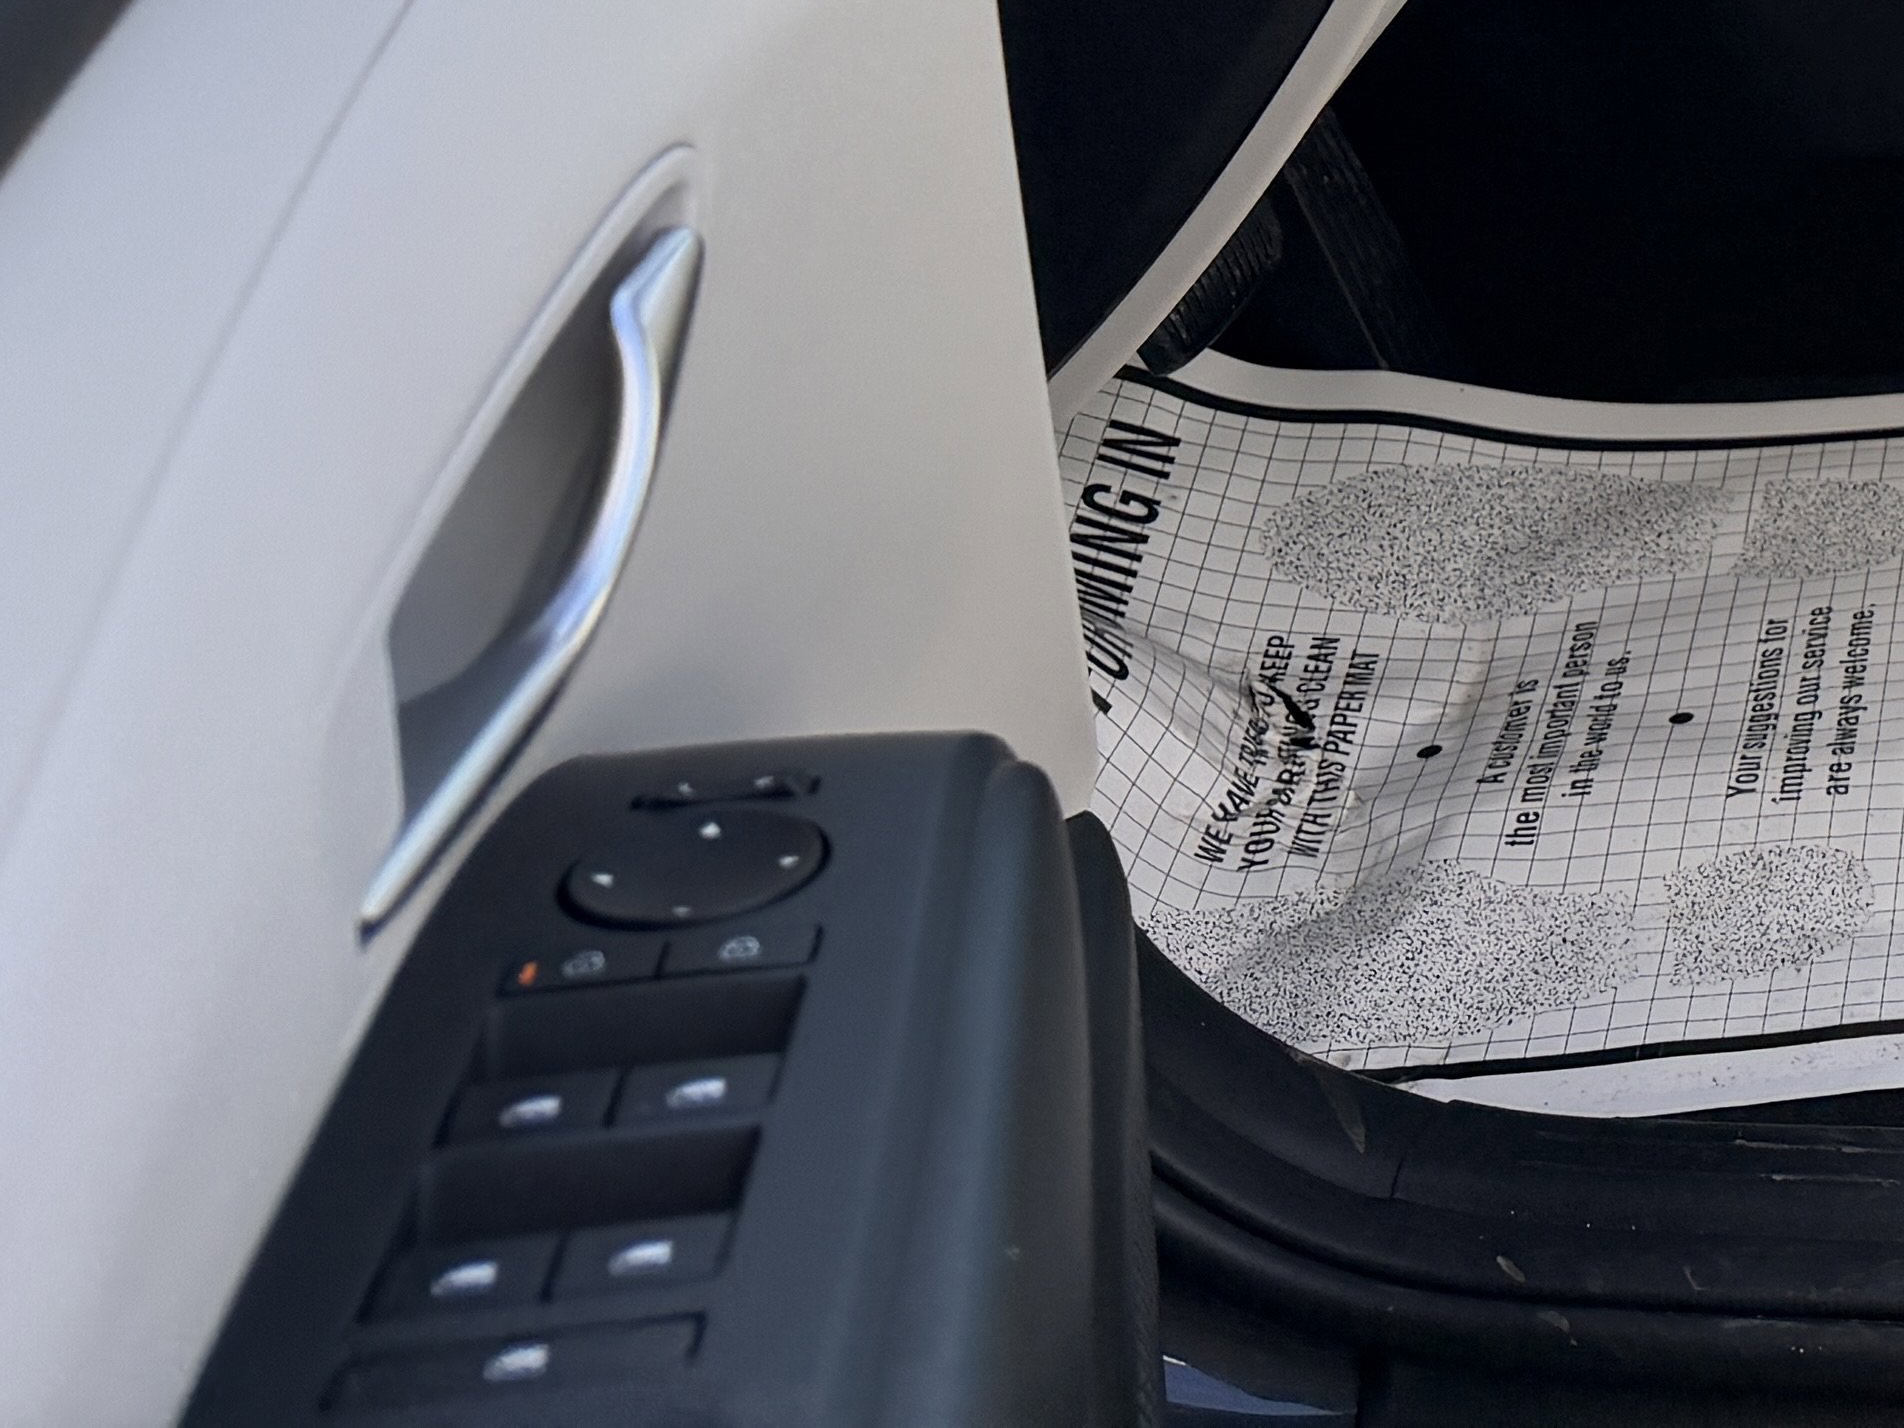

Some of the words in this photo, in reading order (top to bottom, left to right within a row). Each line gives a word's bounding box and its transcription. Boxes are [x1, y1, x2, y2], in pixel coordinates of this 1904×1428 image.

[1097, 419, 1181, 480] IN
[1562, 621, 1597, 678] person
[1757, 618, 1789, 643] for
[1802, 606, 1833, 670] service
[1258, 635, 1295, 683] KEEP
[1343, 649, 1379, 685] MAT
[1509, 679, 1539, 696] is
[1594, 680, 1624, 701] to
[1743, 647, 1783, 750] suggestions
[1796, 674, 1821, 707] our
[1323, 686, 1368, 755] PAPER
[1487, 699, 1533, 770] customer
[1529, 682, 1581, 760] important
[1584, 703, 1618, 746] world
[1826, 694, 1867, 756] always
[1236, 808, 1285, 871] YOUR
[1296, 637, 1341, 694] CLEAN
[1568, 749, 1604, 773] the
[1726, 754, 1762, 798] Your
[1771, 710, 1822, 804] improving
[1211, 767, 1261, 822] HAVE
[1307, 759, 1346, 807] THIS
[1476, 772, 1504, 784] A
[1521, 758, 1554, 803] most
[1561, 778, 1594, 798] in
[1826, 762, 1851, 795] are
[1194, 825, 1233, 863] WE
[1288, 813, 1332, 858] WITH
[1504, 811, 1540, 846] the
